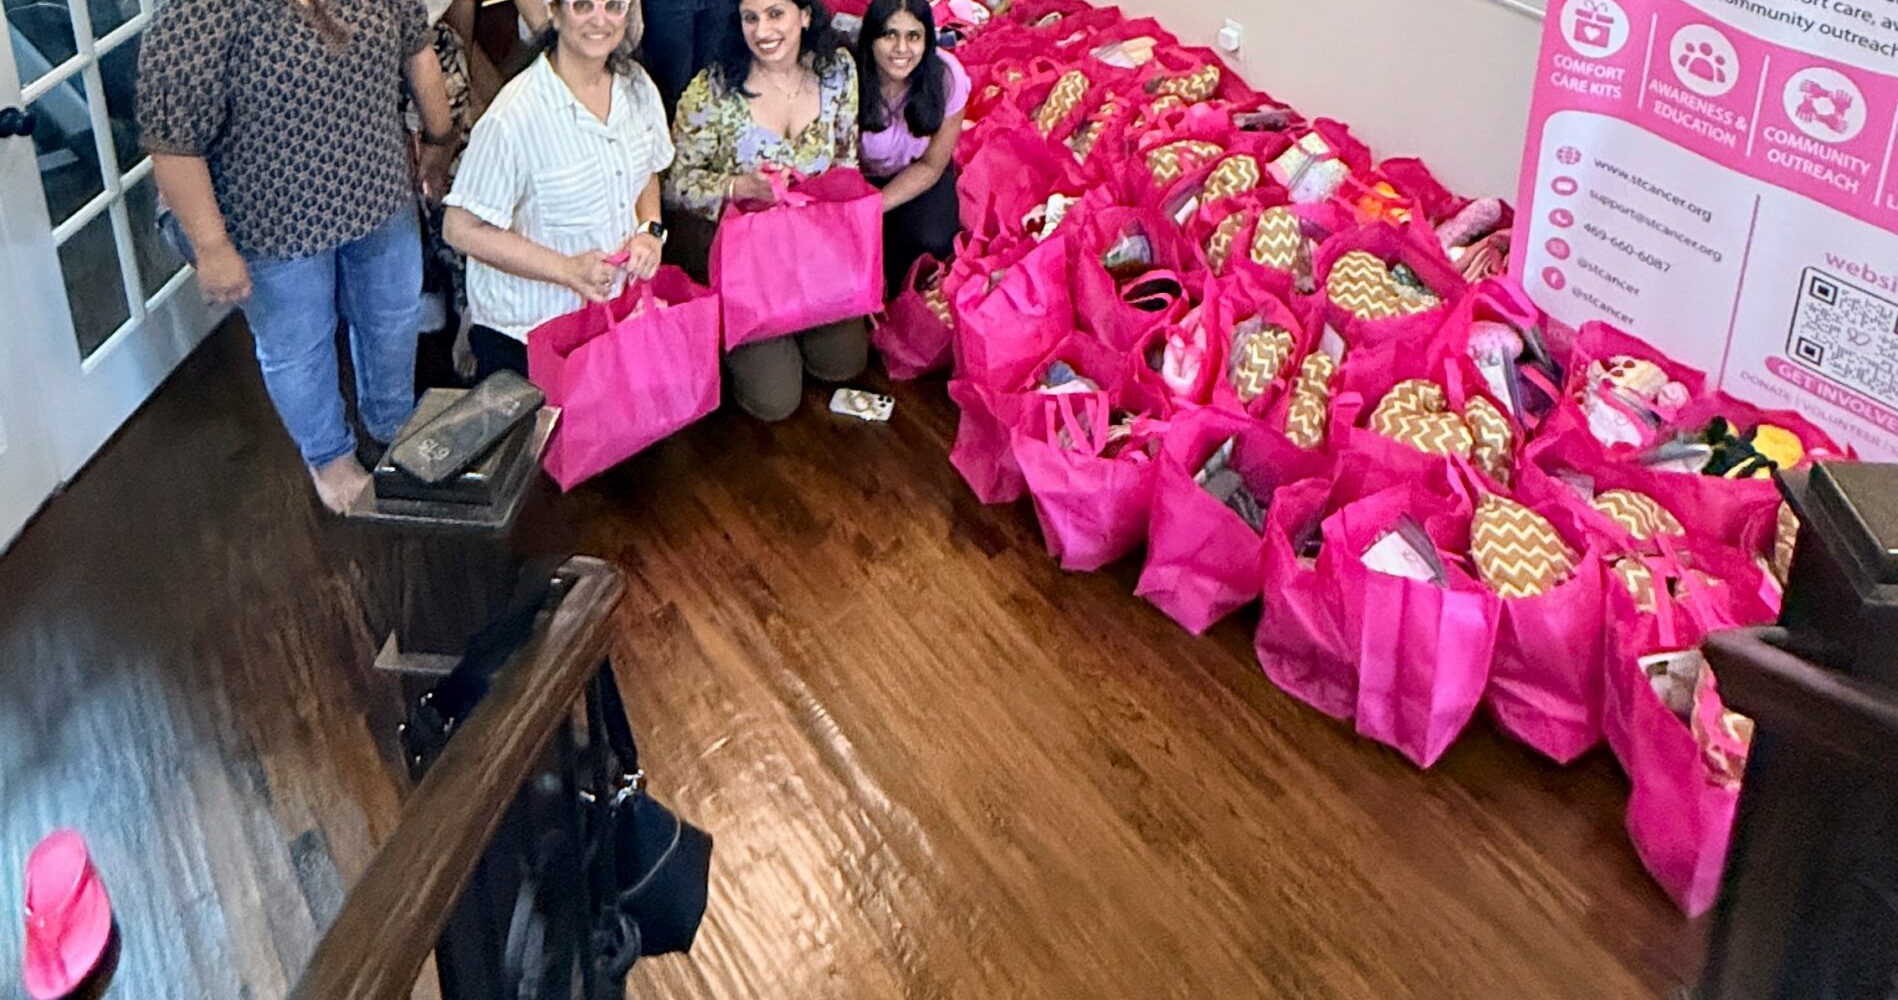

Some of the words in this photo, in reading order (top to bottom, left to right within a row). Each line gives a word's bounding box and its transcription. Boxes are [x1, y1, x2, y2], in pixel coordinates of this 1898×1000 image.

[1833, 0, 1876, 26] care,
[1550, 71, 1588, 93] CARE
[1589, 82, 1622, 99] KITS
[1553, 53, 1625, 81] COMFORT
[1648, 79, 1733, 125] AWARENESS
[1734, 116, 1748, 133] &
[1653, 100, 1736, 148] EDUCATION
[1763, 126, 1871, 176] COMMUNITY
[1767, 148, 1860, 194] OUTREACH
[1594, 157, 1712, 223] www.stcancer.org
[1583, 222, 1671, 272] 469-660-6087
[1589, 189, 1722, 262] support@stcancer.org
[1576, 256, 1640, 296] @stcancer
[1571, 285, 1634, 325] @stcancer
[1777, 363, 1815, 388] GET
